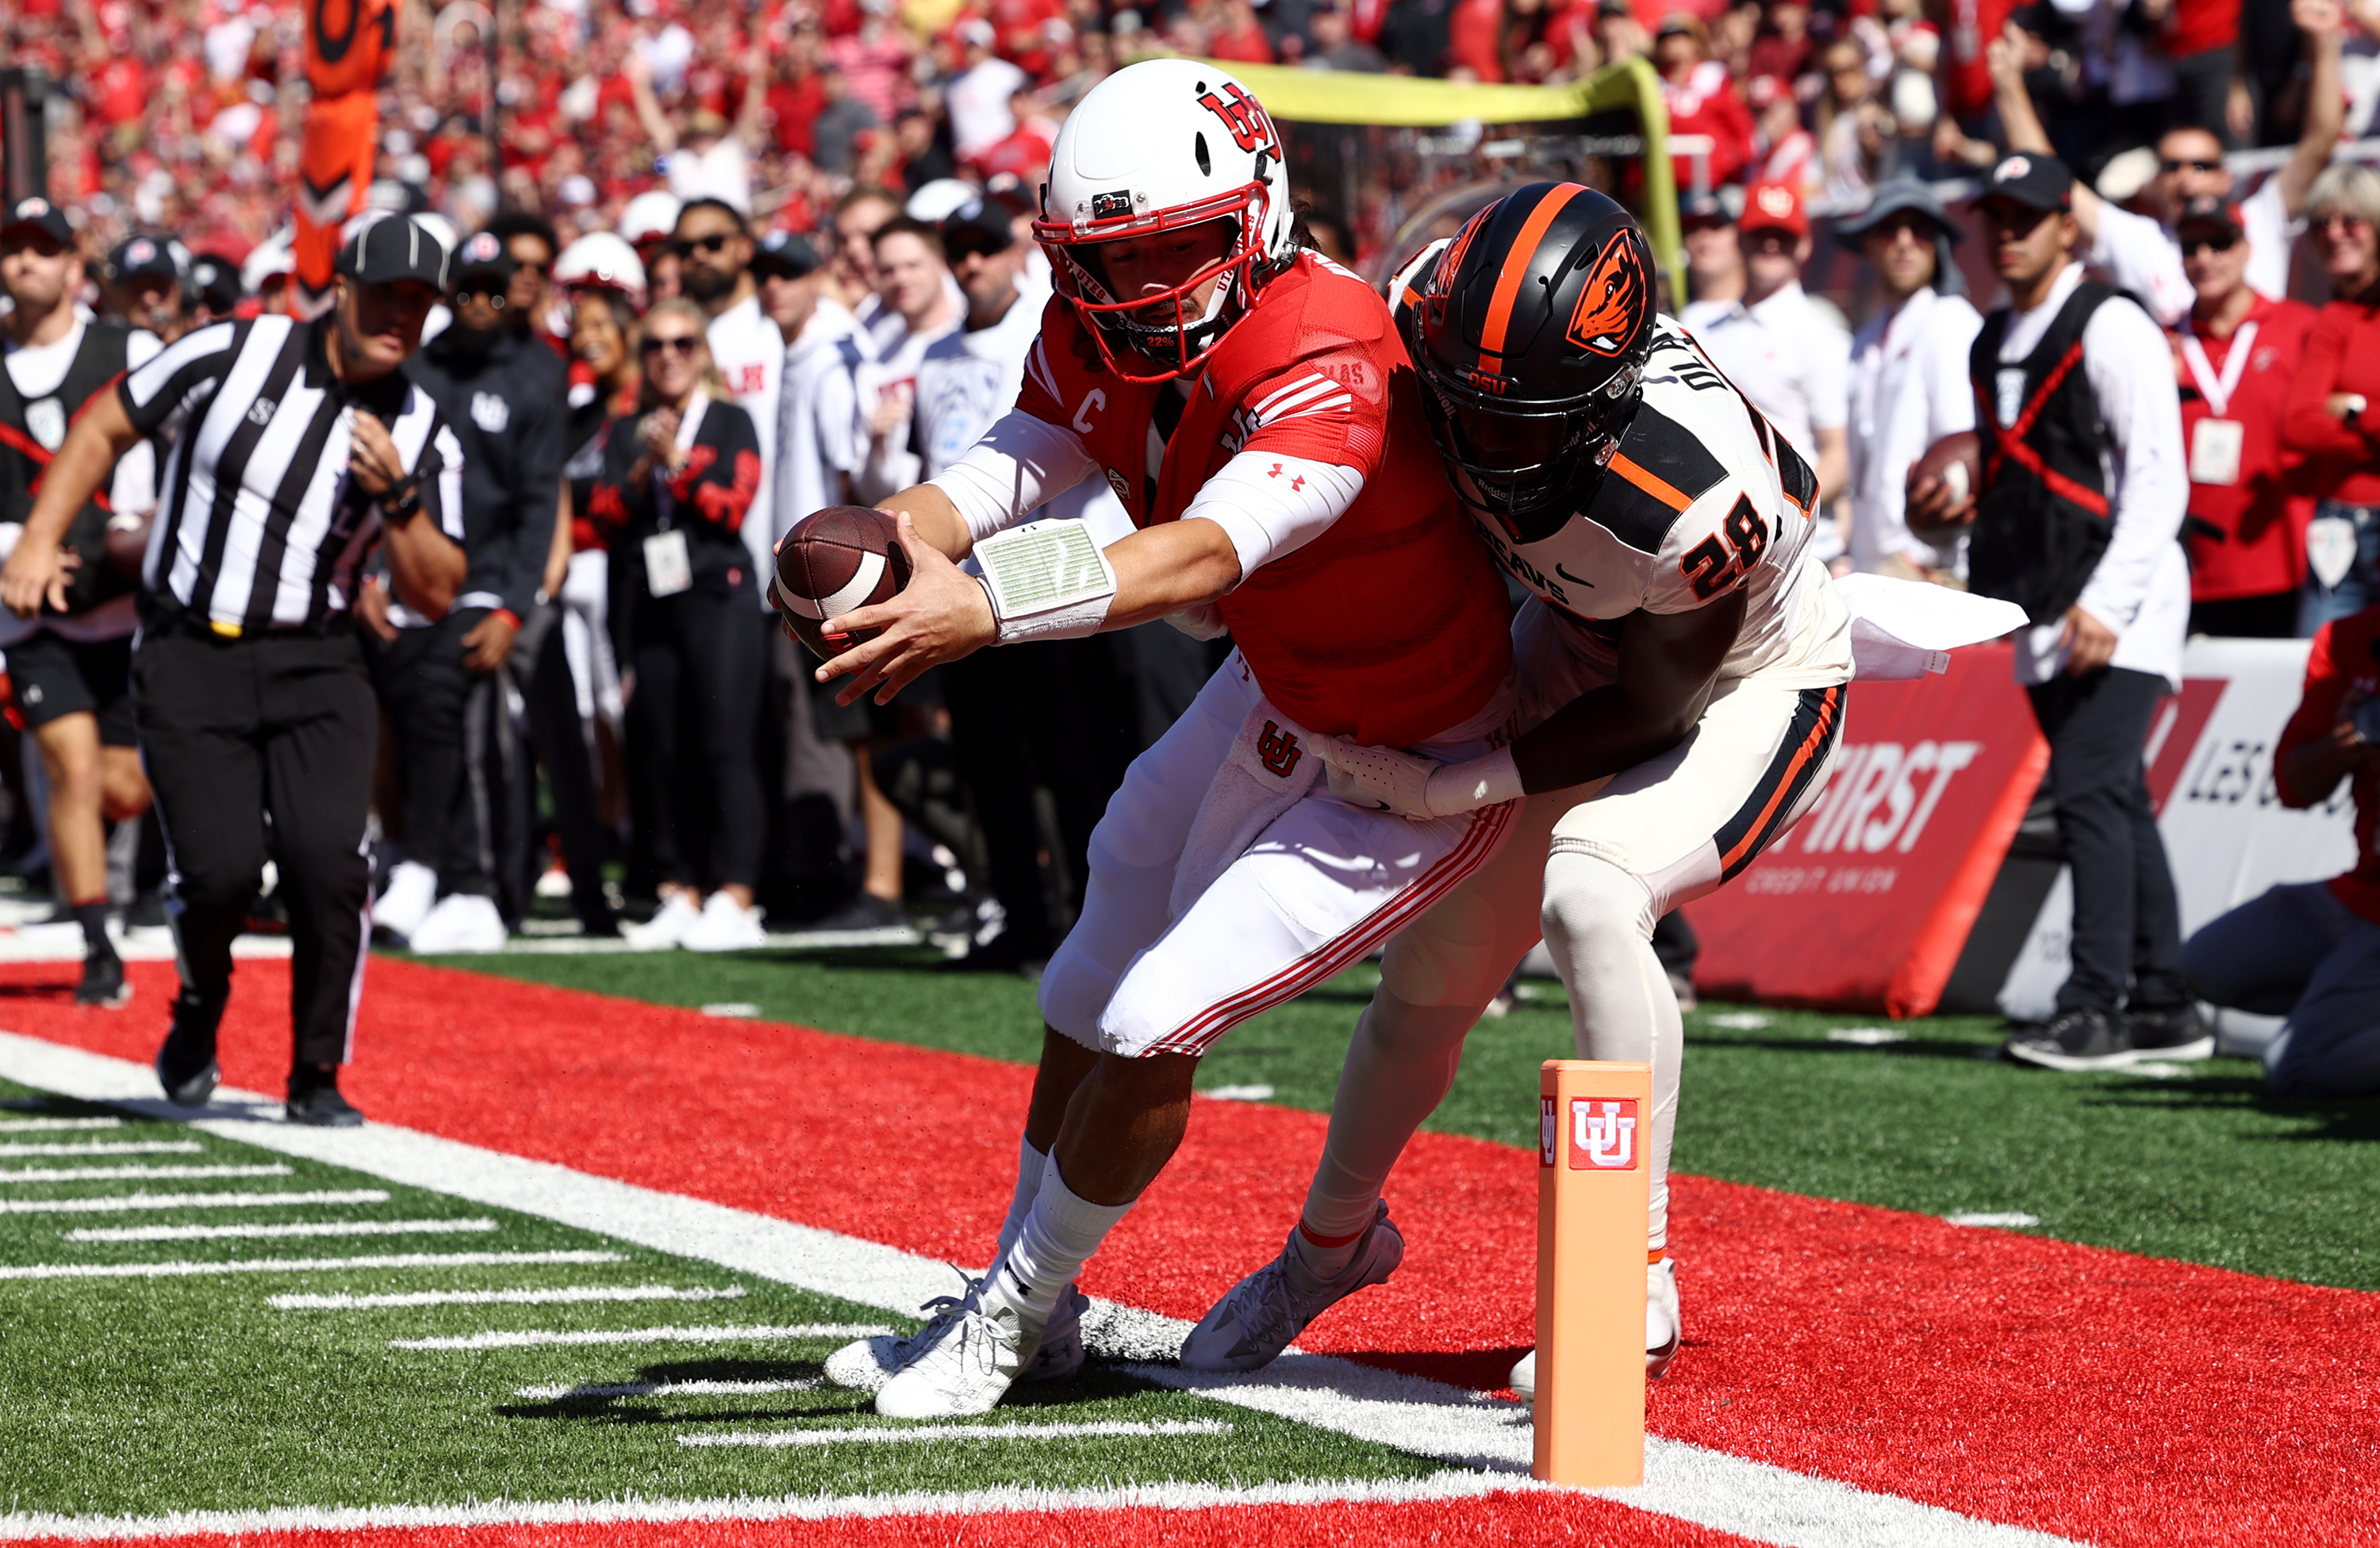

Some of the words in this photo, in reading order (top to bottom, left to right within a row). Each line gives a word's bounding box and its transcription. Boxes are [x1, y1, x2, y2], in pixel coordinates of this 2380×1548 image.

[1147, 336, 1174, 347] 22%
[1469, 371, 1507, 395] OSU
[1073, 387, 1106, 434] C
[1679, 490, 1768, 601] 28
